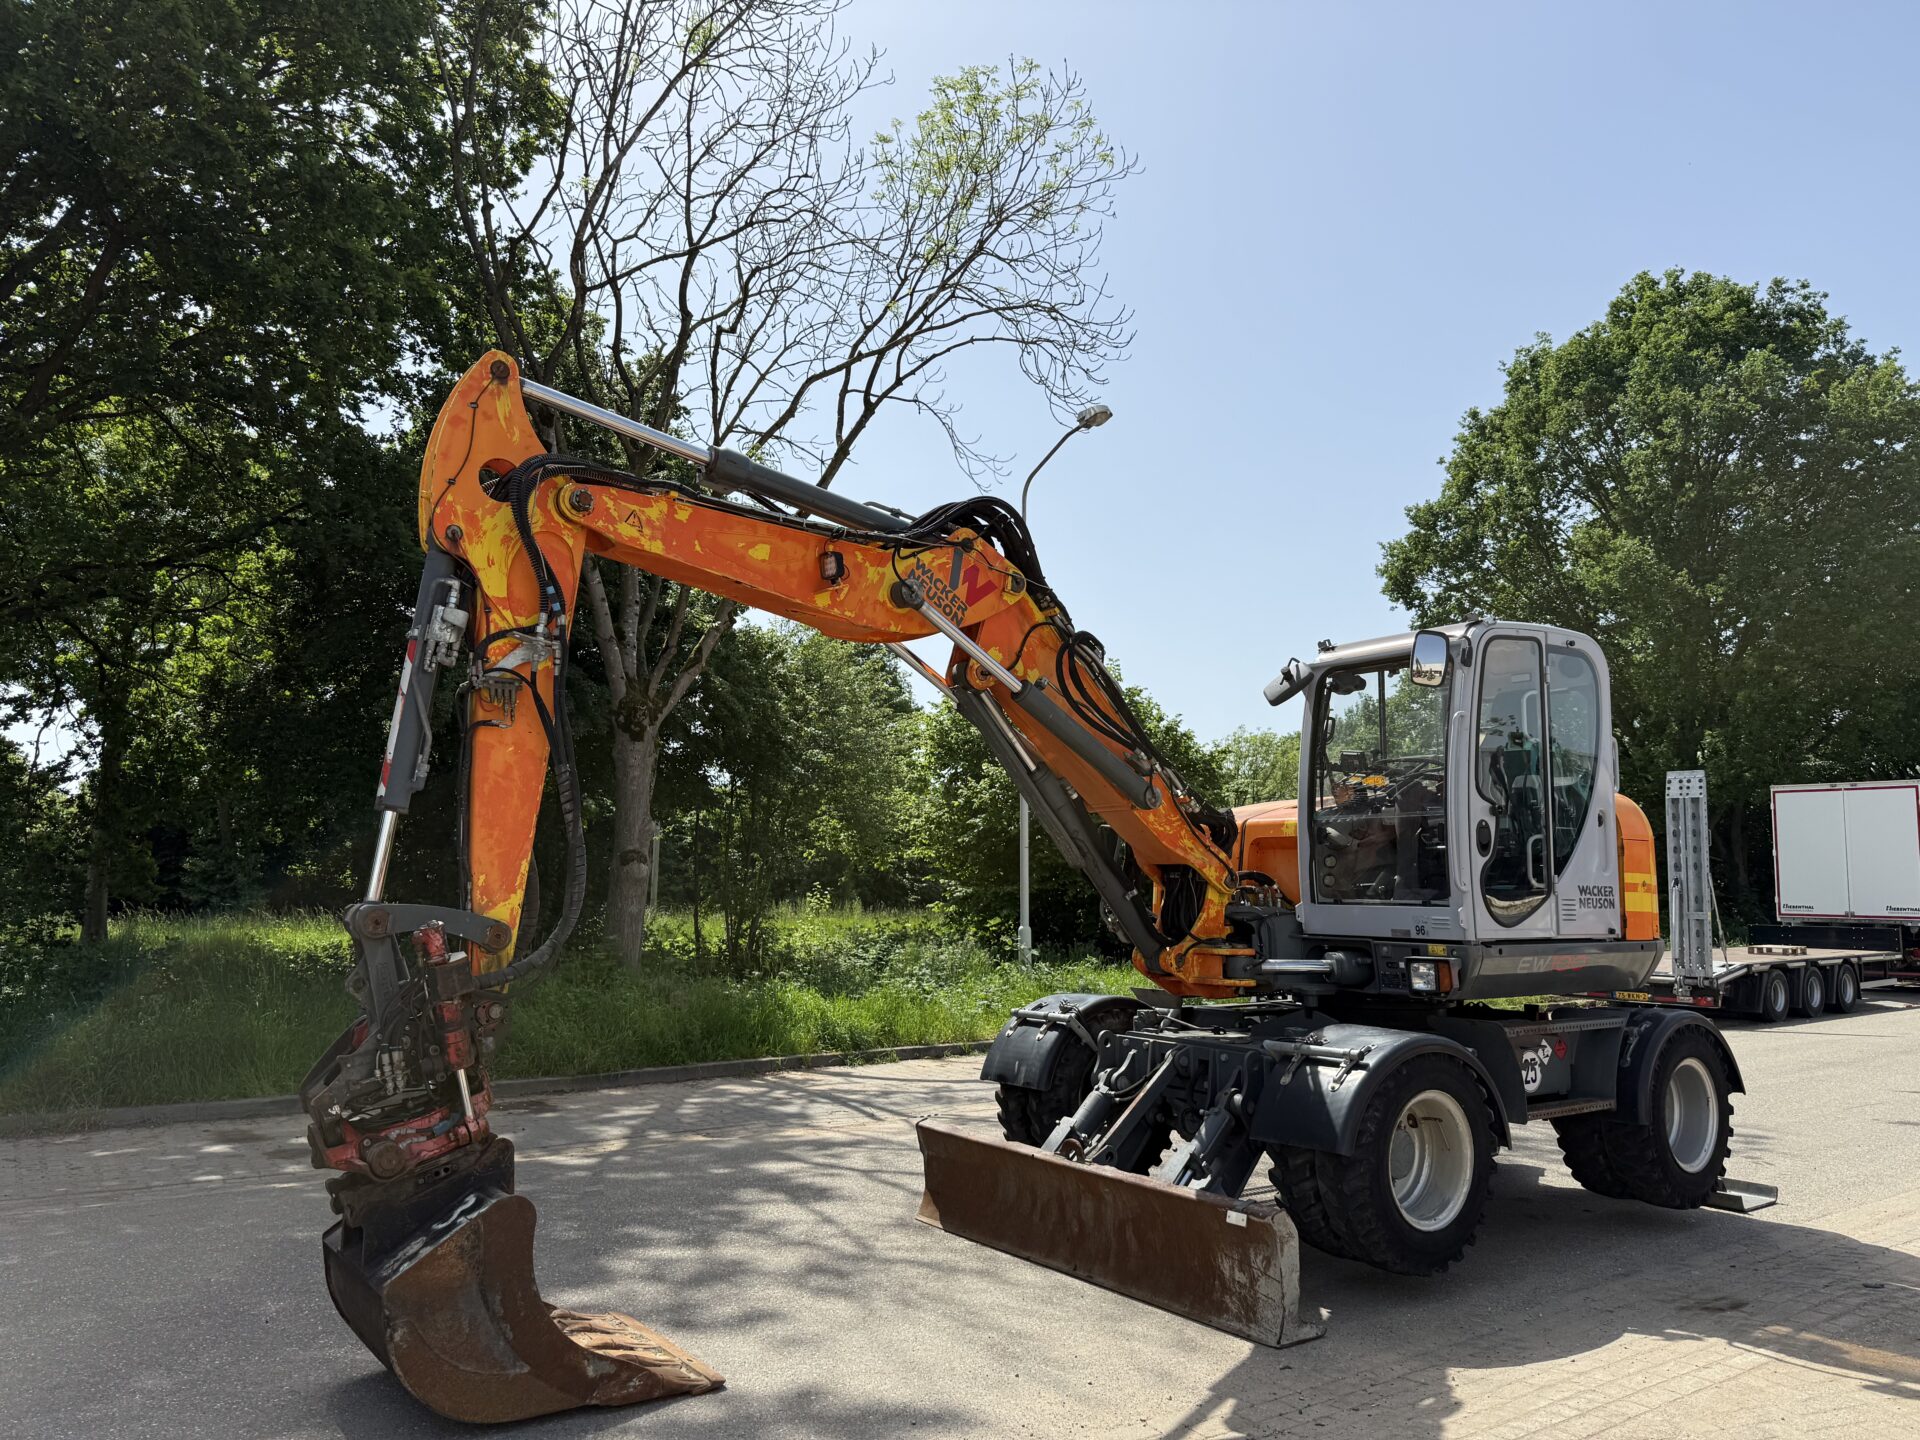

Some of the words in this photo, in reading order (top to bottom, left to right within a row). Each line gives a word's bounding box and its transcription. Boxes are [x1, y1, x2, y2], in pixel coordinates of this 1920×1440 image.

[915, 556, 969, 618] WACKER
[1577, 884, 1615, 898] WACKER
[1578, 897, 1616, 910] NEUSON
[1415, 924, 1426, 936] 96
[1523, 1057, 1537, 1084] 25
